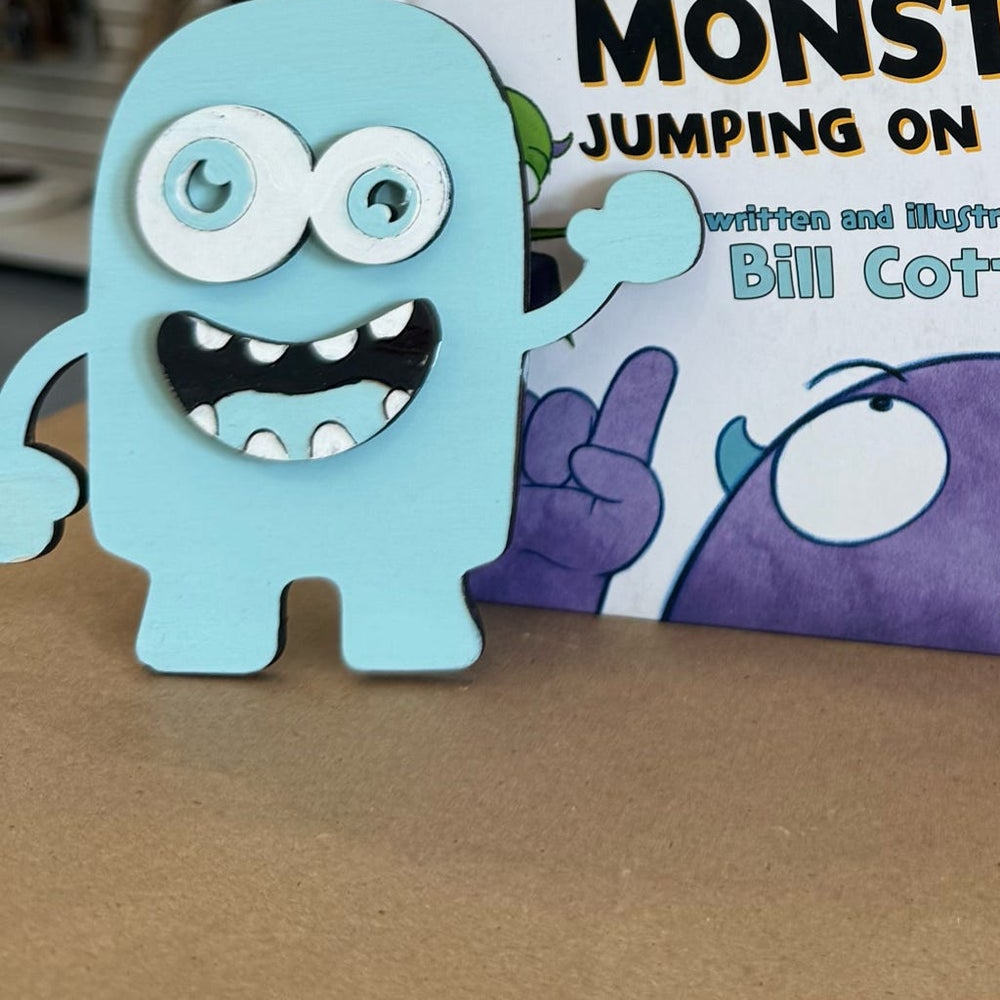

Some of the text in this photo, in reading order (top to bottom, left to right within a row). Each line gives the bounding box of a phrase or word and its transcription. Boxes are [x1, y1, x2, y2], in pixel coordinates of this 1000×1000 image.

[579, 107, 866, 160] JUMPING
[887, 104, 987, 156] ON
[704, 204, 831, 232] written
[841, 203, 895, 231] and
[729, 242, 834, 300] Bill
